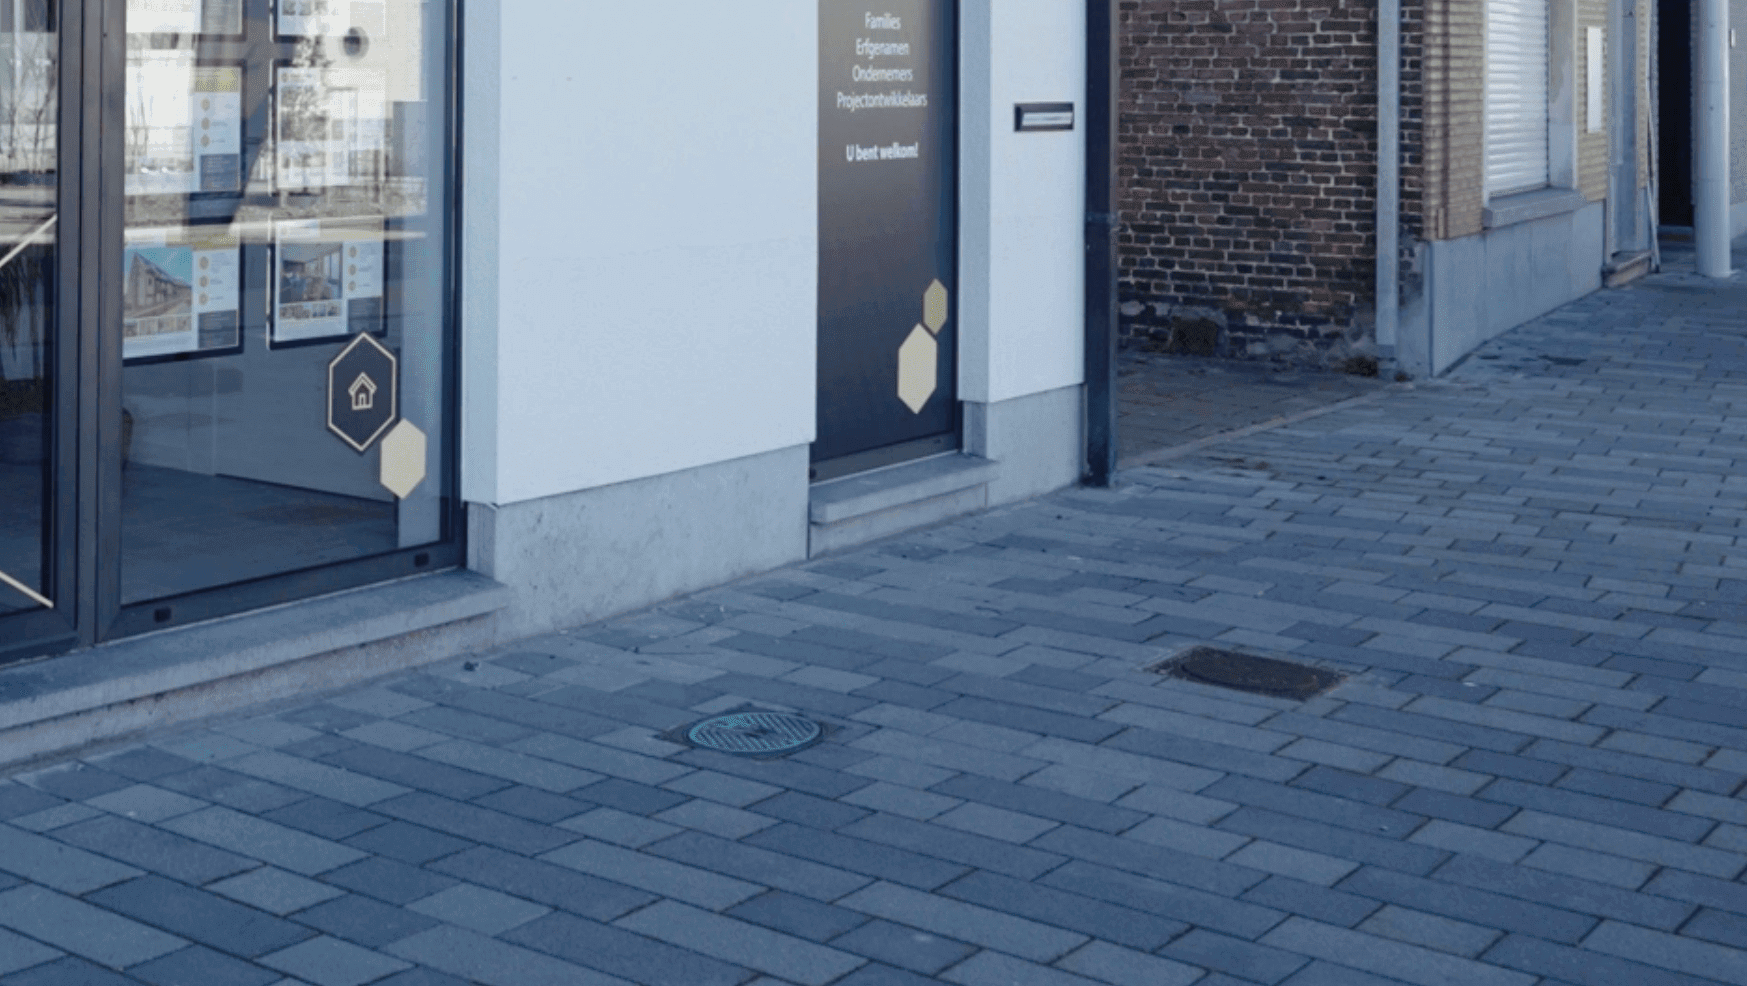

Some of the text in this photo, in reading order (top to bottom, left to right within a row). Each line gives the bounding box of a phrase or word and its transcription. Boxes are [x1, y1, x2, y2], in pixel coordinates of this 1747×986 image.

[865, 11, 901, 30] Families
[855, 38, 909, 60] Erfgenamen
[852, 64, 913, 82] Ondernemers
[836, 90, 928, 113] Projectontwikkelaars
[846, 141, 919, 162] U bent welkom!
